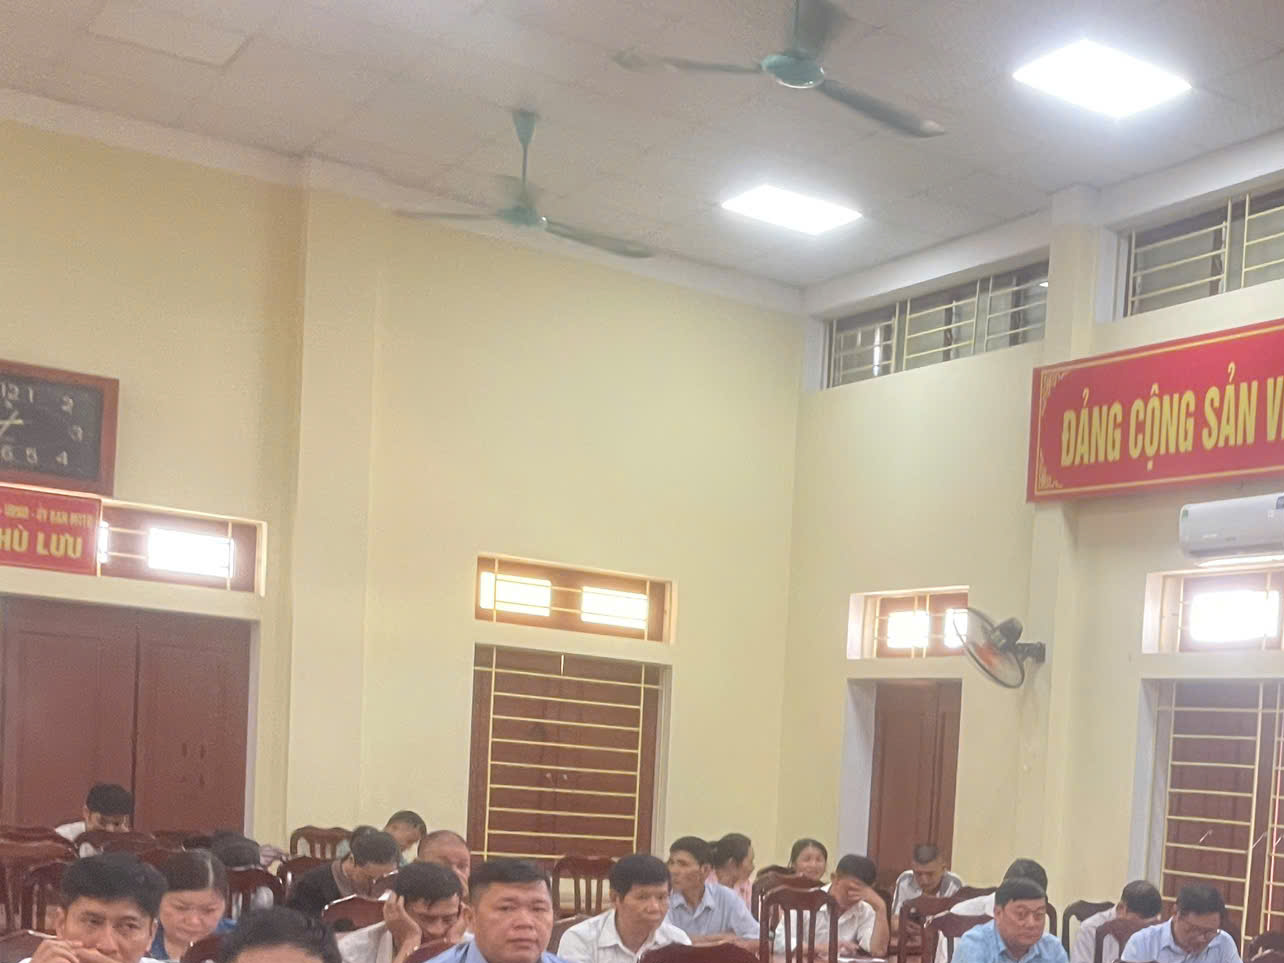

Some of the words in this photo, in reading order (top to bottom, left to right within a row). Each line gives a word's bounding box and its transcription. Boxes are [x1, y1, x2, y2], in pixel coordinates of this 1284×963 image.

[1060, 388, 1122, 467] ĐẢNG
[1128, 383, 1195, 471] CỘNG
[1201, 361, 1257, 450] SẢN
